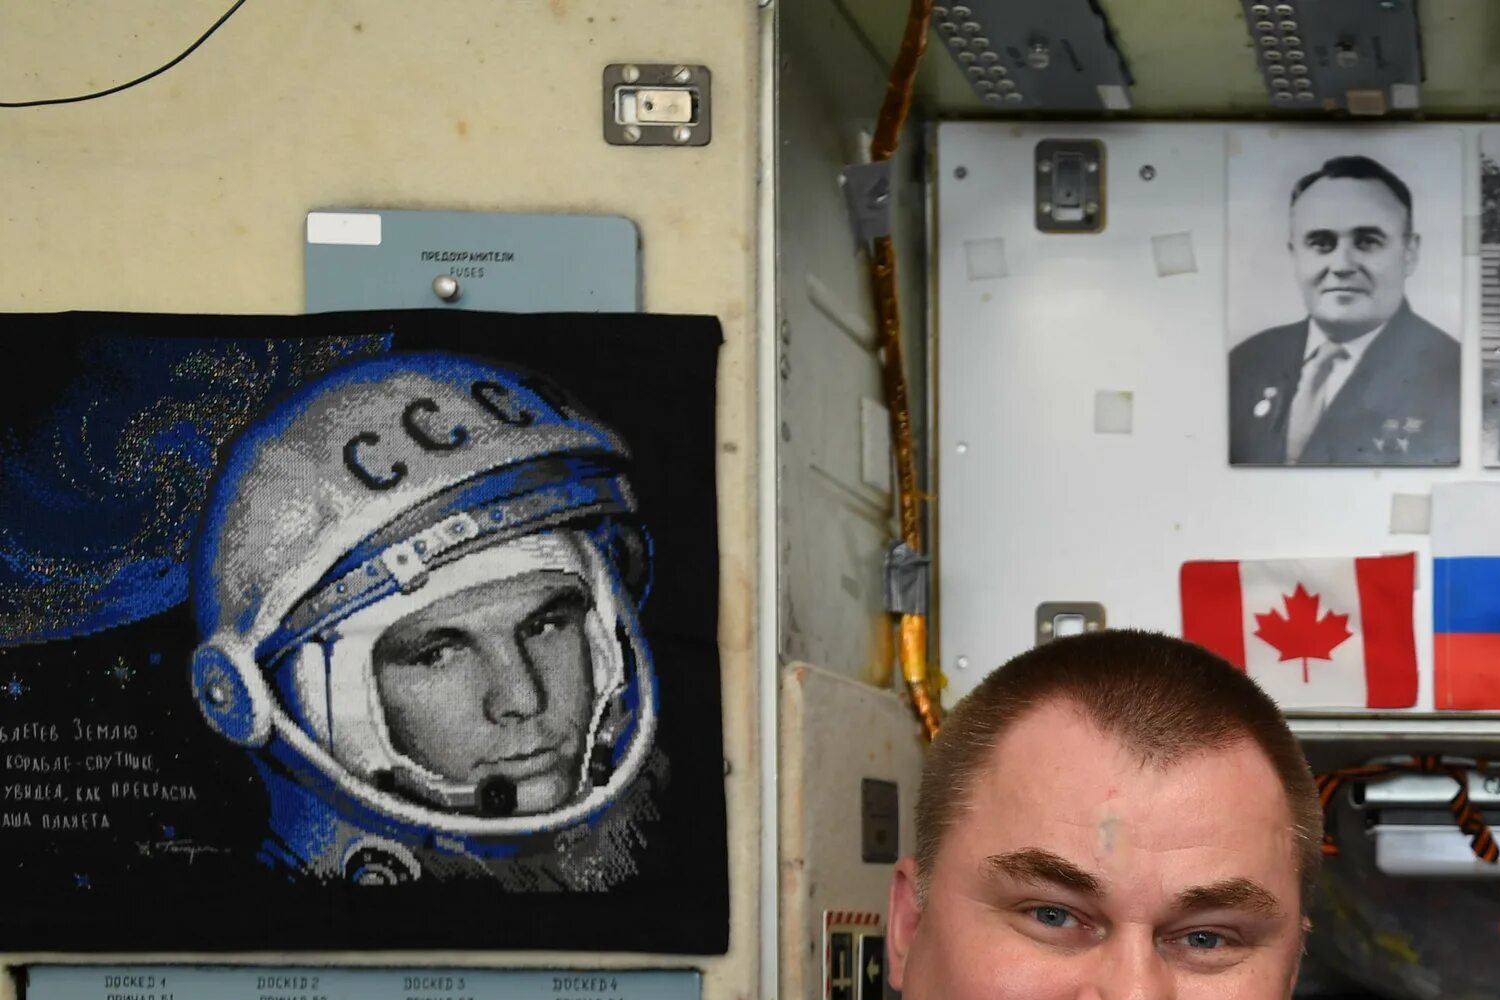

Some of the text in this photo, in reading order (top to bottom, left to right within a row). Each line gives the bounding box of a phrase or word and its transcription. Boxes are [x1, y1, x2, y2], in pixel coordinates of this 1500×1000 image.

[421, 251, 514, 262] ПРЕДОХРАНИТЕЛИ
[450, 266, 485, 278] FUSES
[73, 718, 138, 742] ЗЕМЛЮ
[76, 786, 101, 801] КАК
[112, 781, 197, 800] ПРЕКРАСНА
[42, 813, 110, 830] ПЛАНЕТА
[105, 975, 155, 989] DOCKED
[257, 976, 308, 990] DOCKED
[404, 976, 453, 991] DOCKED
[552, 977, 607, 992] DOCKED
